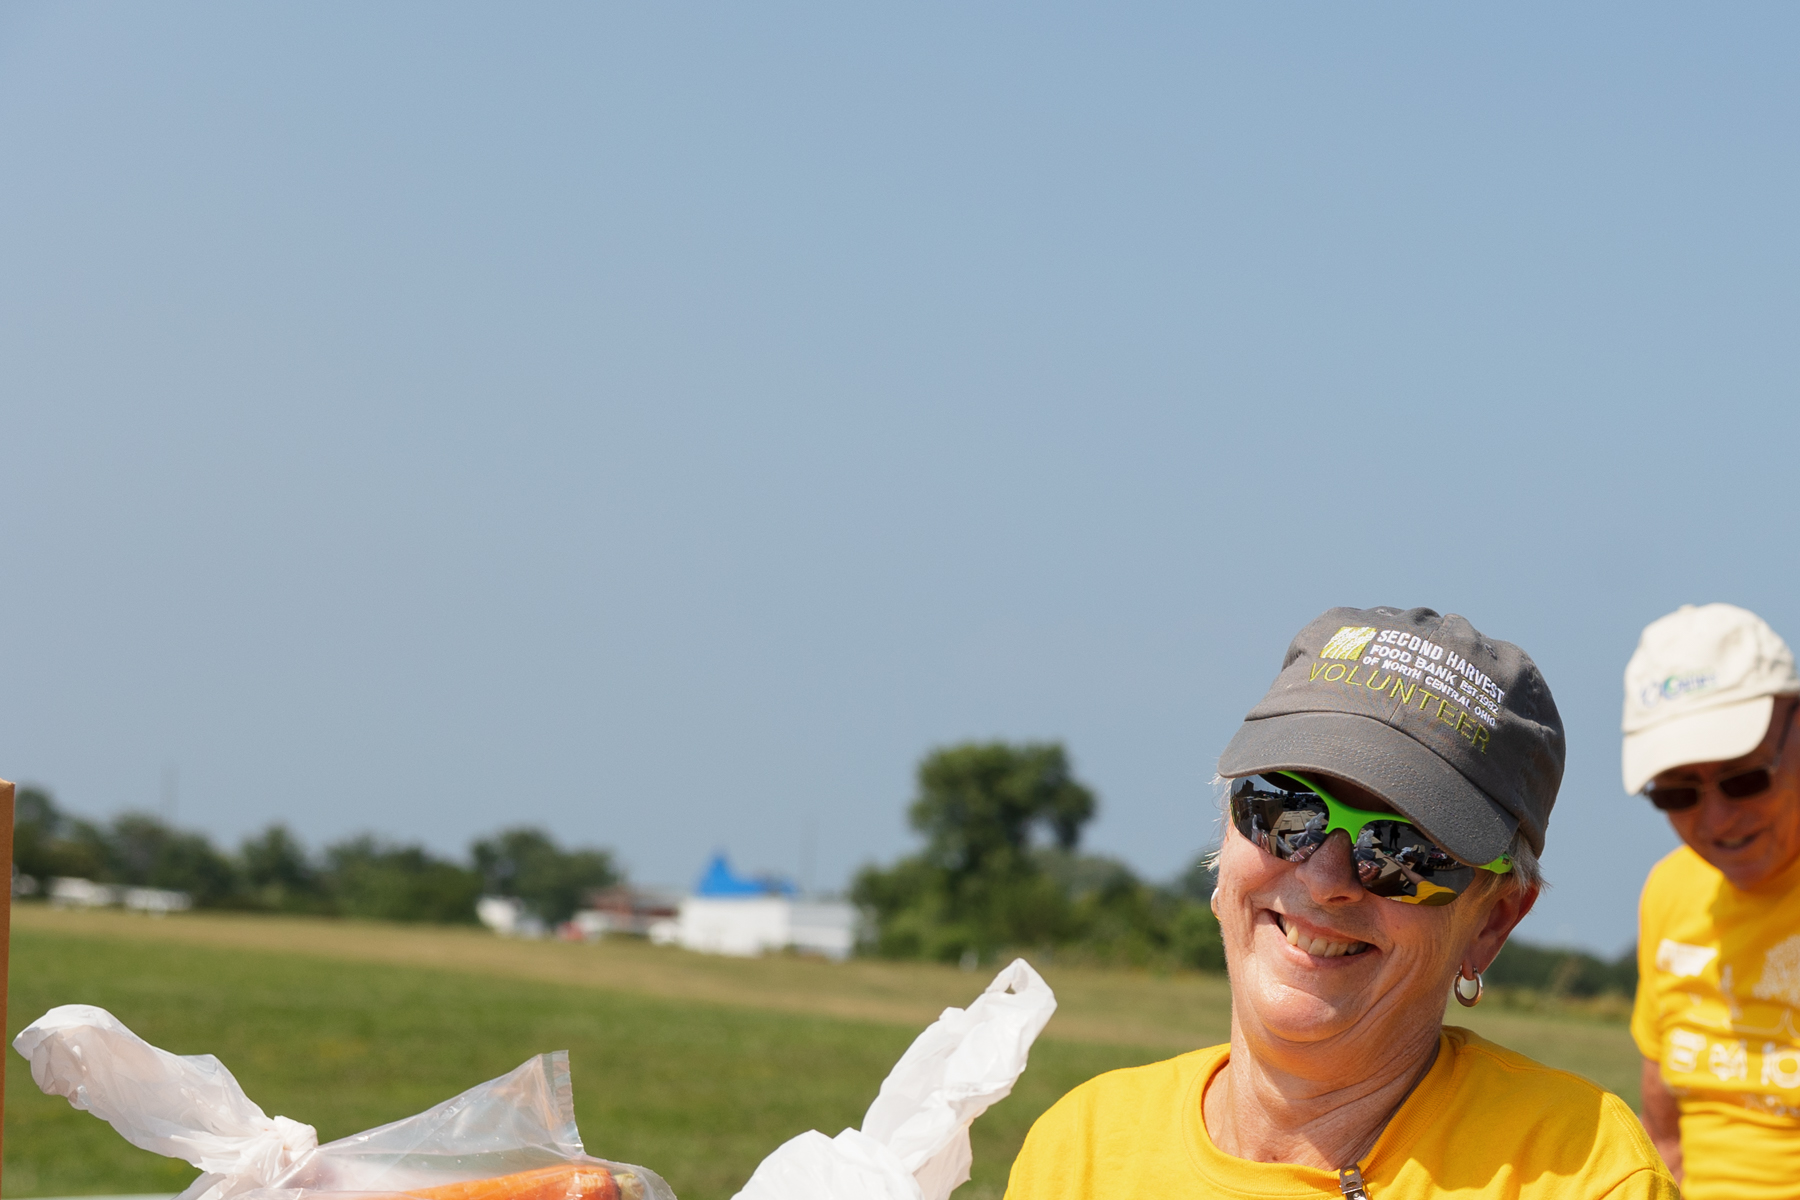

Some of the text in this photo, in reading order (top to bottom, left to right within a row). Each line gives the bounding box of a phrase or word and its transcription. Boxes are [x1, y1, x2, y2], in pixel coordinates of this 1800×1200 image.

[1362, 656, 1496, 727] OF NORTH CENTRAL OHIO
[1370, 644, 1458, 686] FOOD BANK
[1377, 630, 1505, 703] SECOND HARVEST
[1308, 662, 1491, 755] VOLUNTEER
